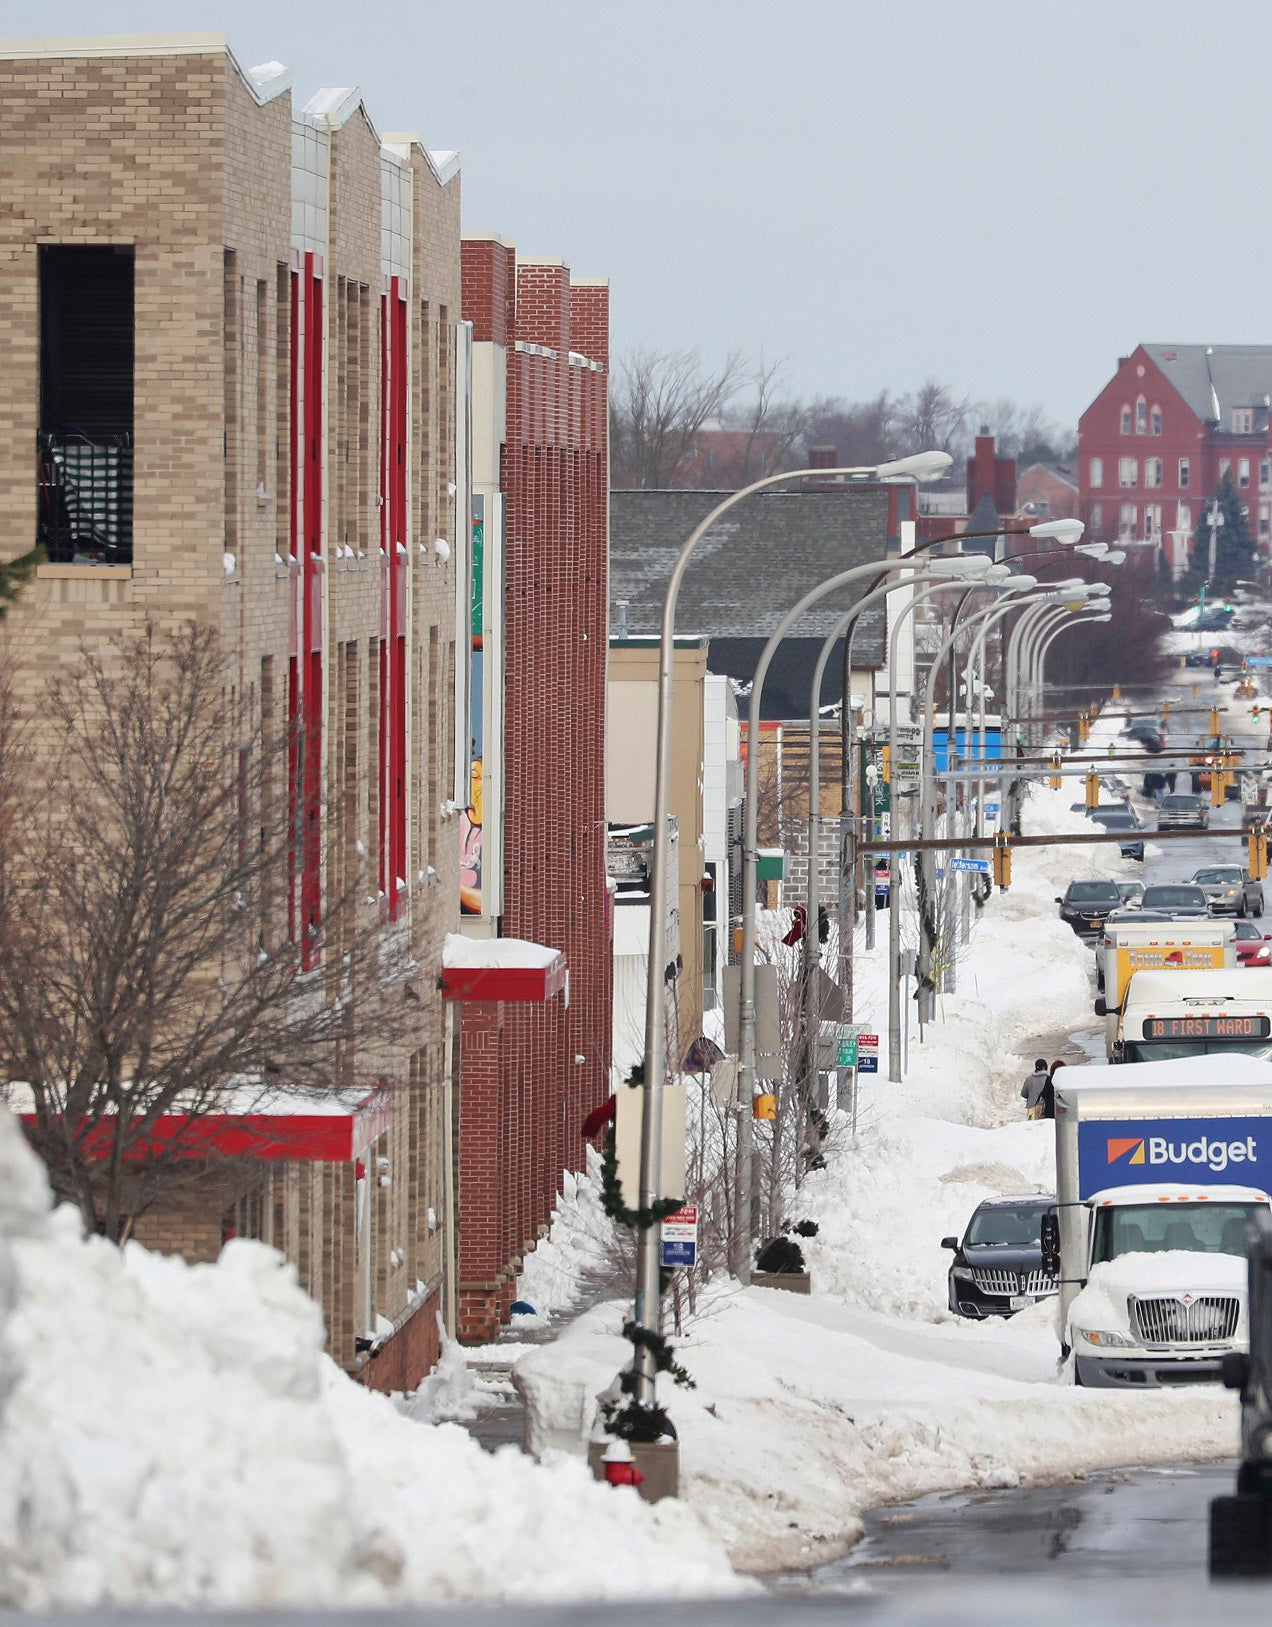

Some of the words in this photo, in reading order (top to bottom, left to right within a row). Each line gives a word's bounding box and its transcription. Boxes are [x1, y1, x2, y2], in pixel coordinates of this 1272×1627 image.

[1152, 1020, 1165, 1036] 18
[1171, 1019, 1211, 1036] FIRST
[1217, 1018, 1254, 1035] WARD
[1149, 1136, 1257, 1172] Budget
